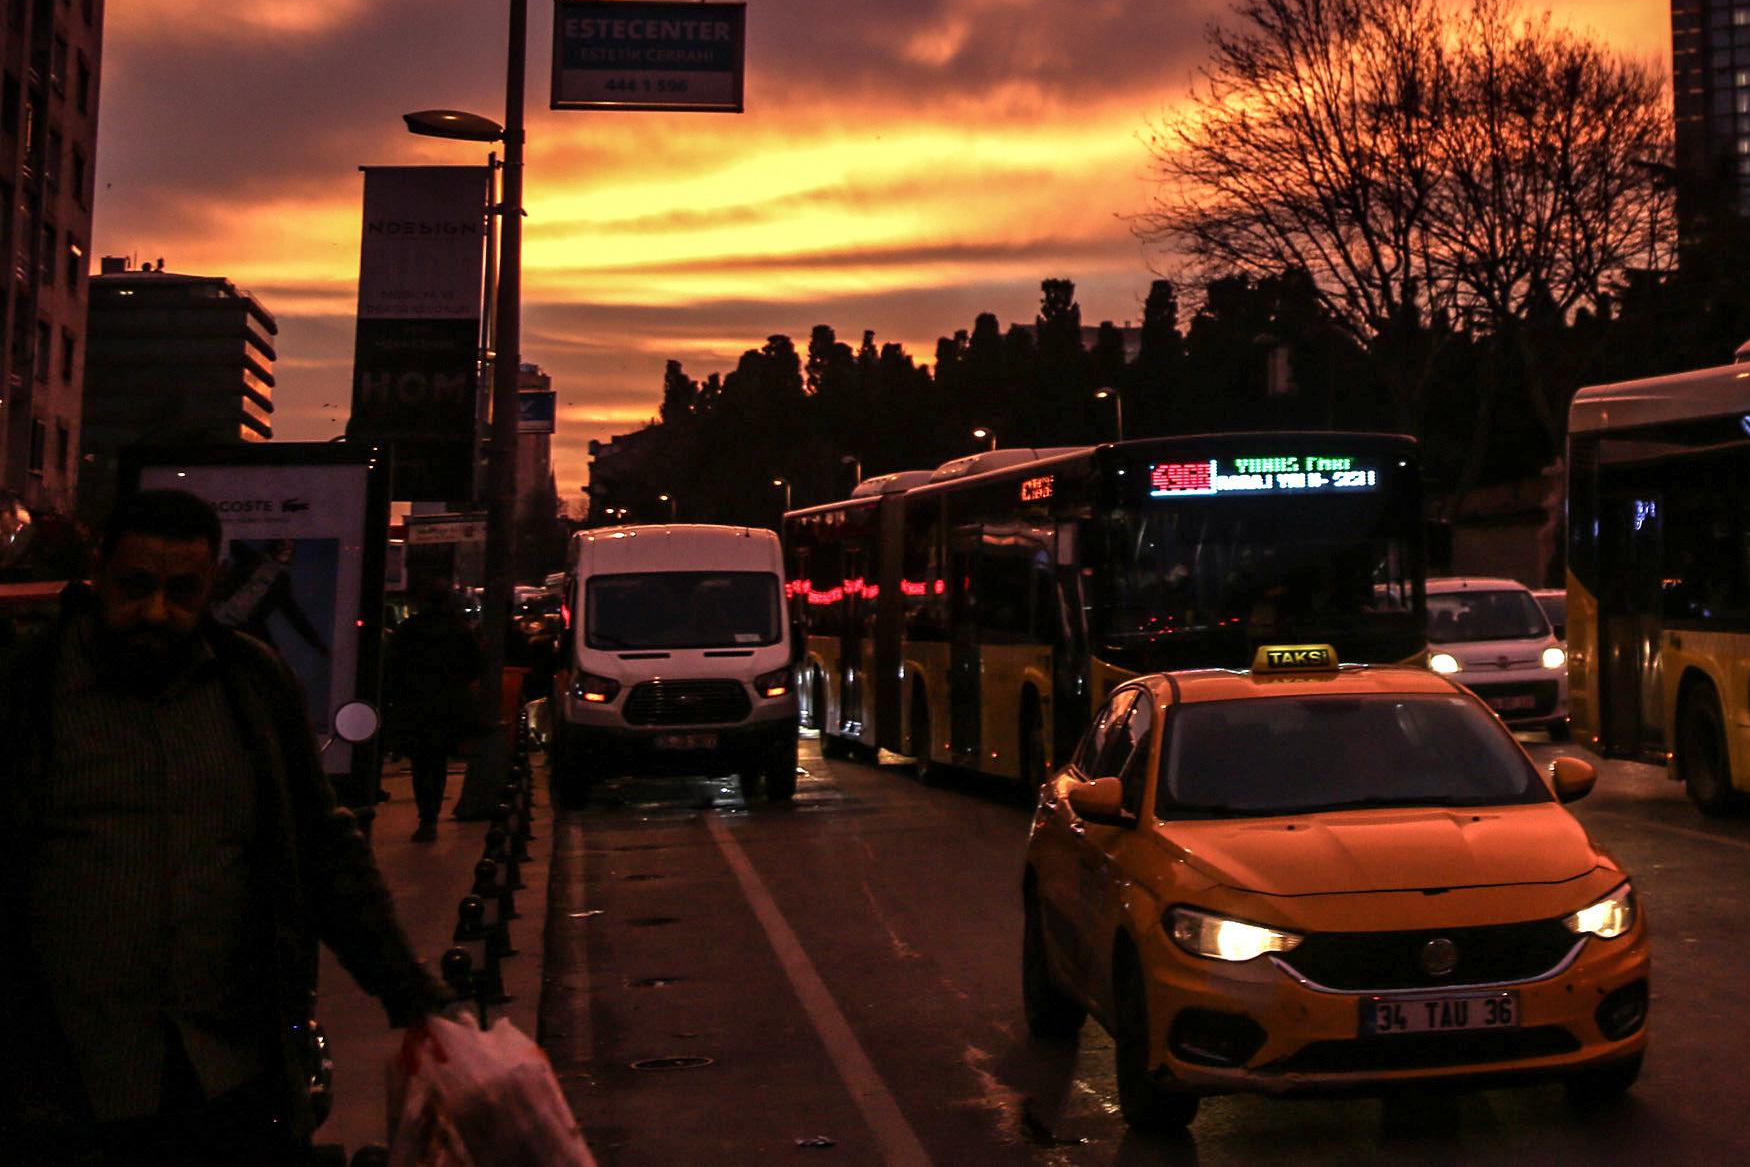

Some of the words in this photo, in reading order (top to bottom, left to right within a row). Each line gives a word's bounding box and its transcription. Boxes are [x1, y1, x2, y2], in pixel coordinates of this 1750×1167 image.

[565, 18, 731, 41] ESTECENTER
[605, 79, 635, 91] 444
[642, 80, 652, 91] 1
[1378, 1005, 1407, 1030] 34
[1425, 1001, 1468, 1027] TAU
